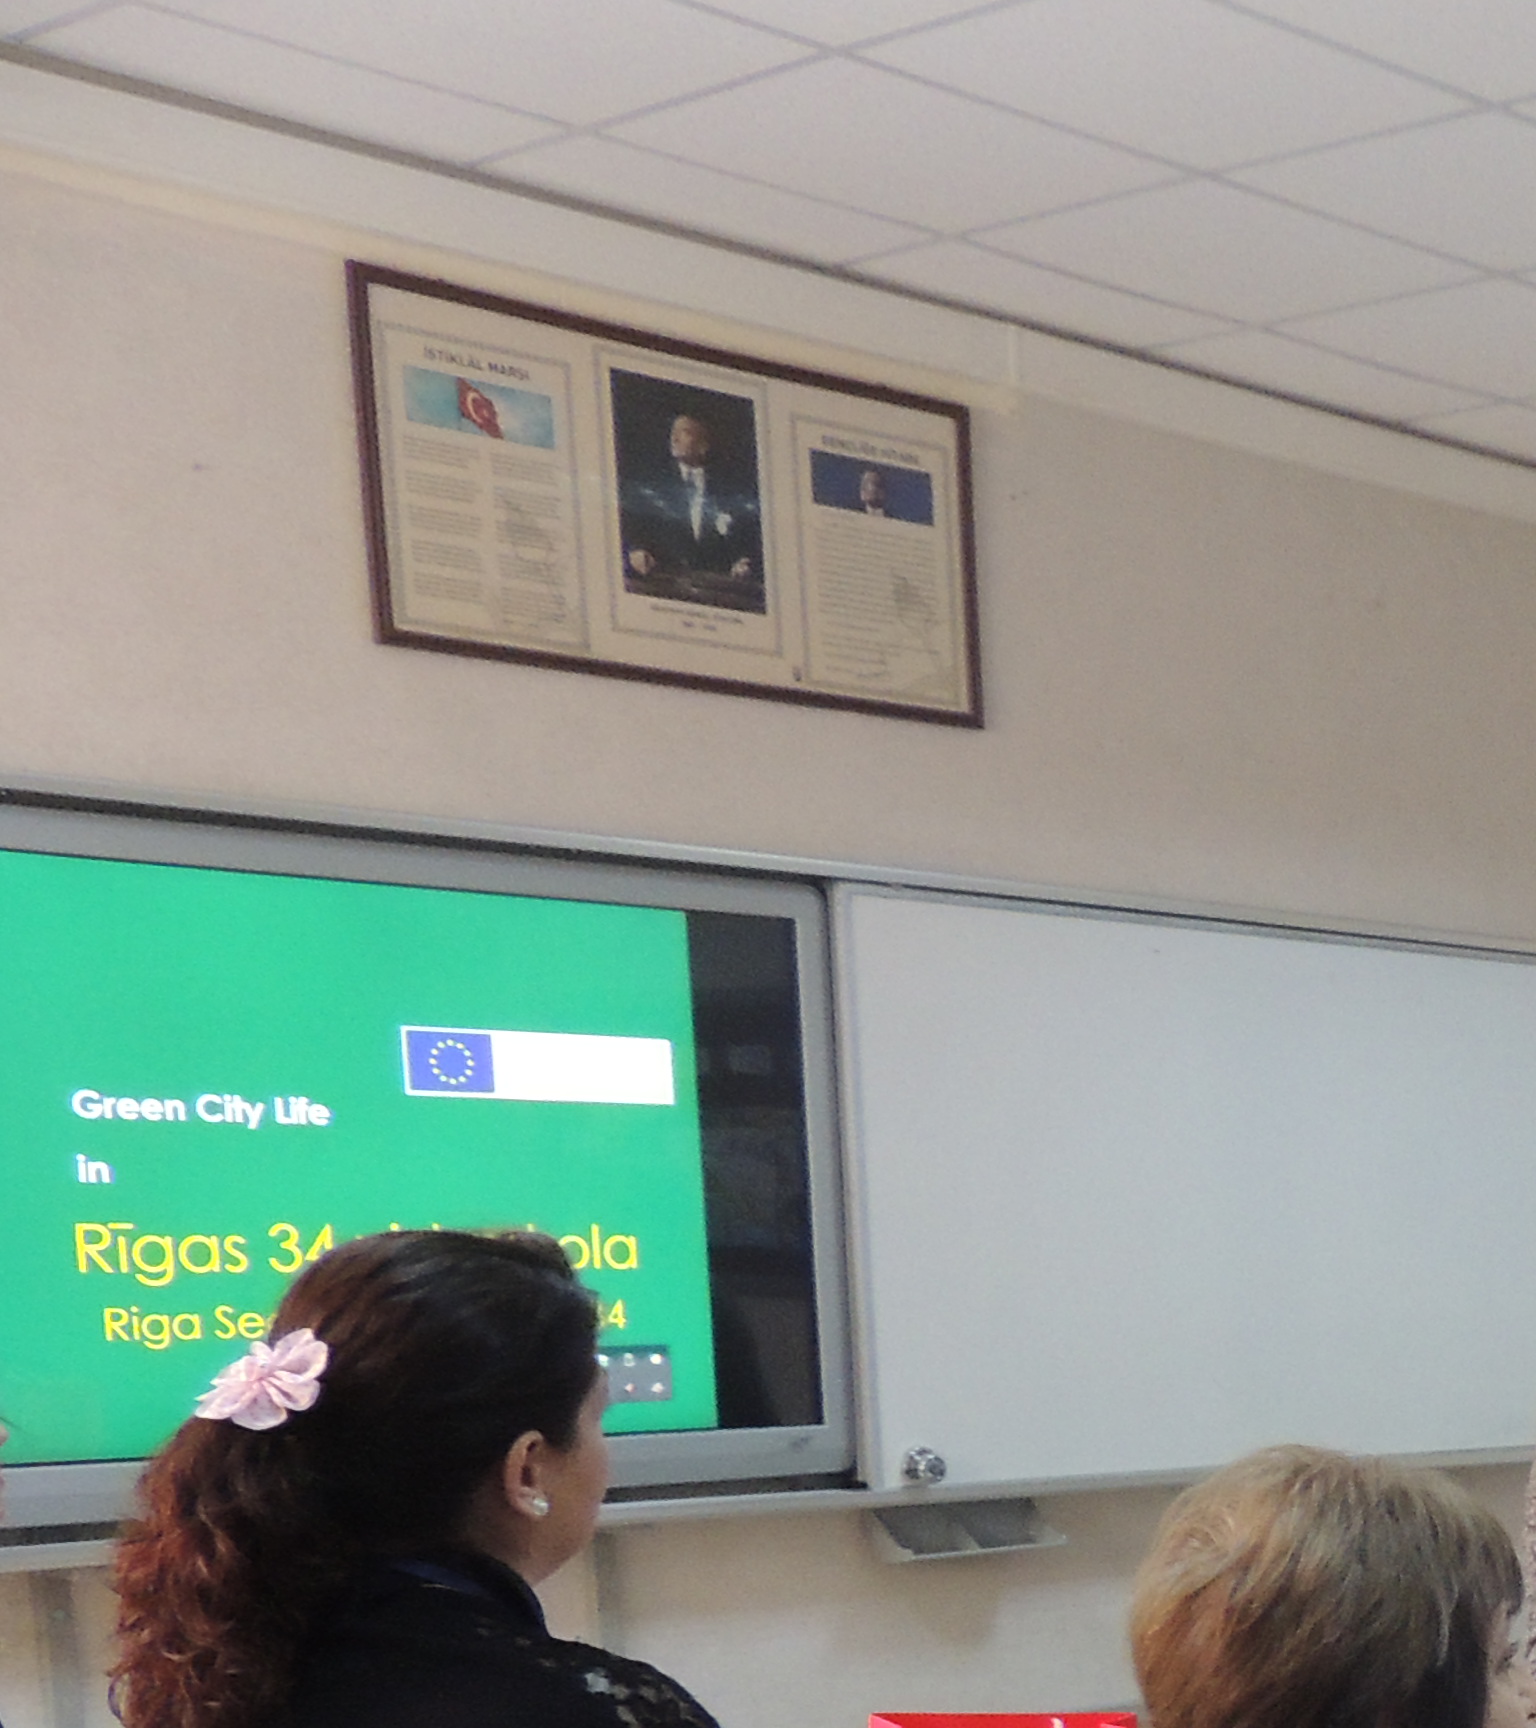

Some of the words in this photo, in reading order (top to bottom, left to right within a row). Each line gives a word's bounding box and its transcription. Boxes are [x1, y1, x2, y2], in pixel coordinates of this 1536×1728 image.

[72, 1089, 187, 1121] Green
[196, 1094, 264, 1130] City
[274, 1095, 332, 1126] Life
[76, 1153, 112, 1183] in
[75, 1223, 249, 1287] Rīgas
[103, 1306, 202, 1350] Riga
